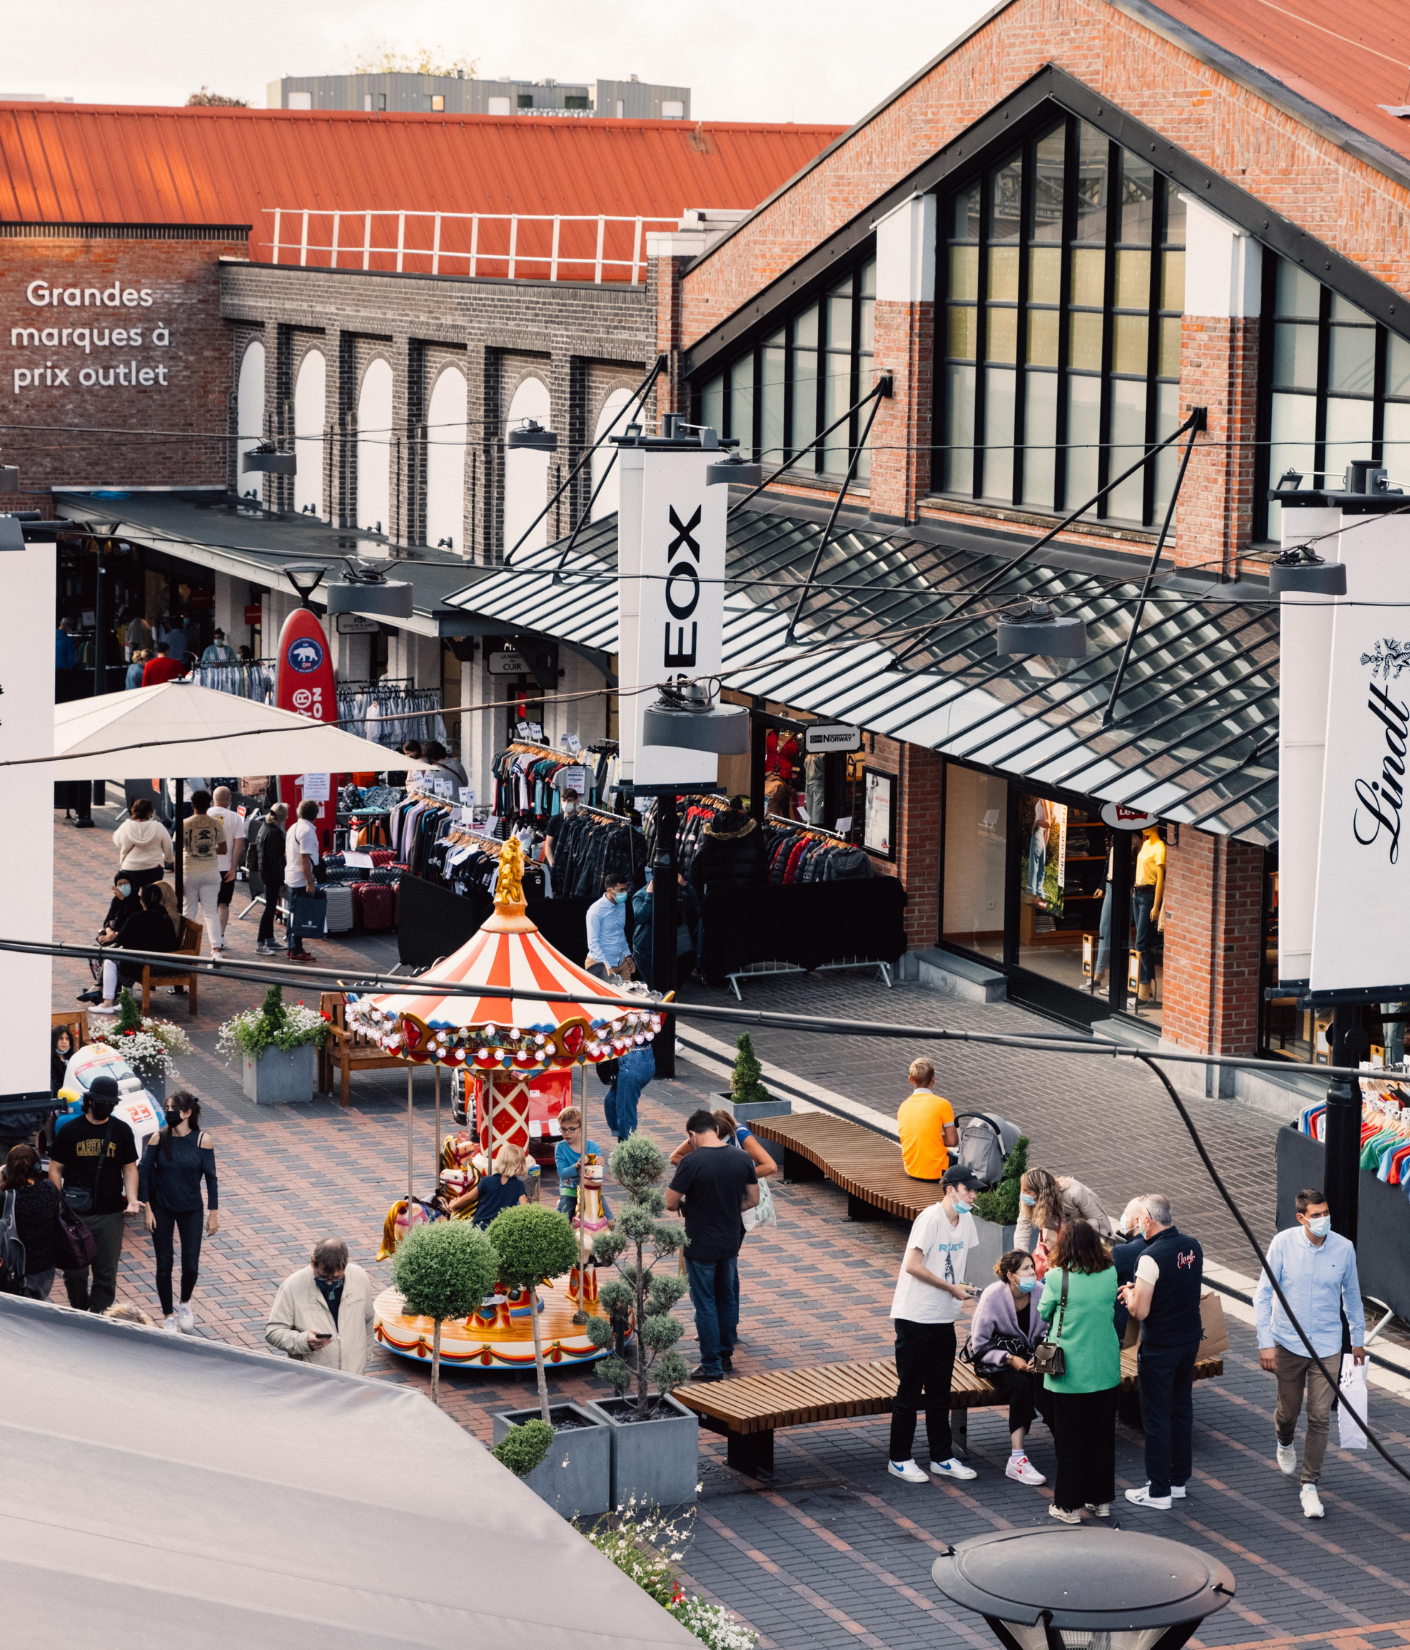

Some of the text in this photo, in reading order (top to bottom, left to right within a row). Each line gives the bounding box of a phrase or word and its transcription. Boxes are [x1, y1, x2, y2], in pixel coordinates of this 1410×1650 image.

[26, 280, 153, 307] Grandes
[11, 322, 170, 354] marques à
[13, 360, 168, 394] prix outlet
[503, 663, 522, 671] CUIR
[823, 733, 852, 743] NORWAY
[1353, 682, 1410, 865] Lindt
[126, 1103, 152, 1123] 23
